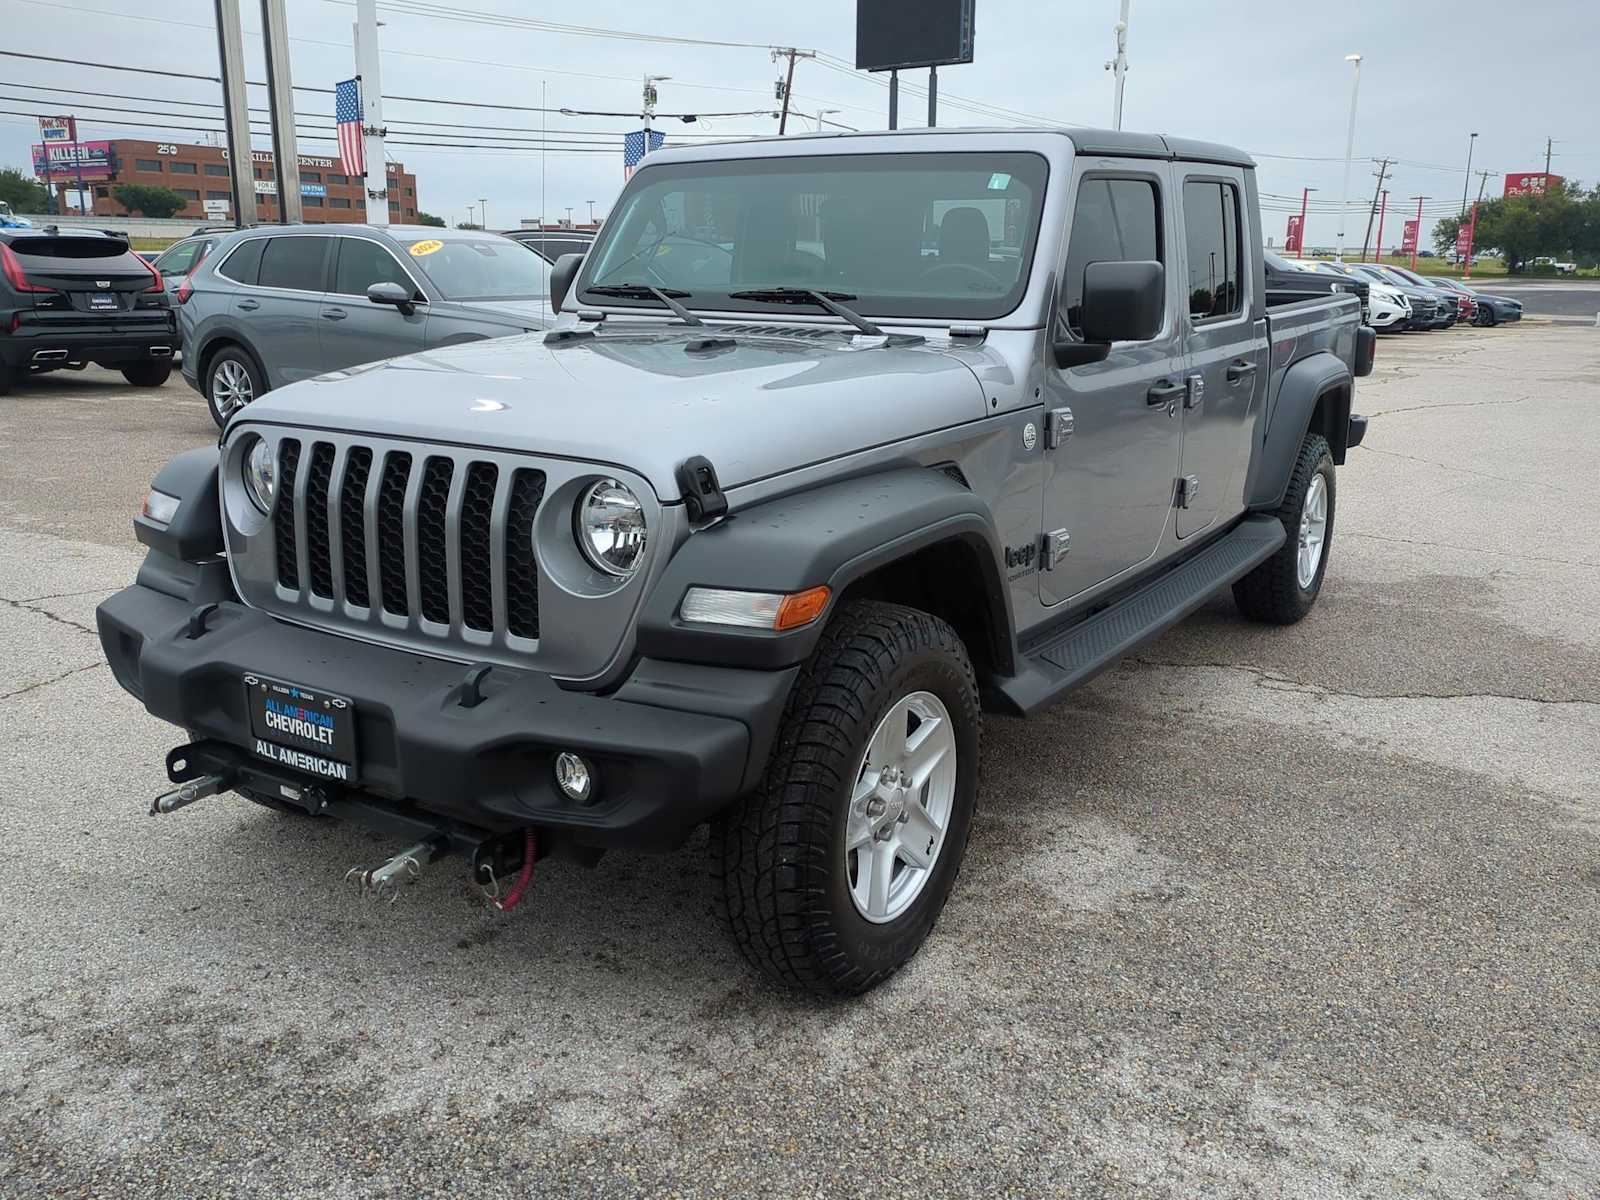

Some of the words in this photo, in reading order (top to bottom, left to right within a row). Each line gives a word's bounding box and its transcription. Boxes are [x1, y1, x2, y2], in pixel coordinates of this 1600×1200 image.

[48, 146, 89, 160] KILLEEN
[412, 240, 441, 254] 2024
[1005, 542, 1036, 568] Jeep
[265, 698, 283, 713] ALL
[283, 703, 335, 729] AMERICAN
[265, 710, 335, 745] CHEVROLET
[256, 740, 278, 760] ALL
[279, 747, 348, 780] AMERICAN
